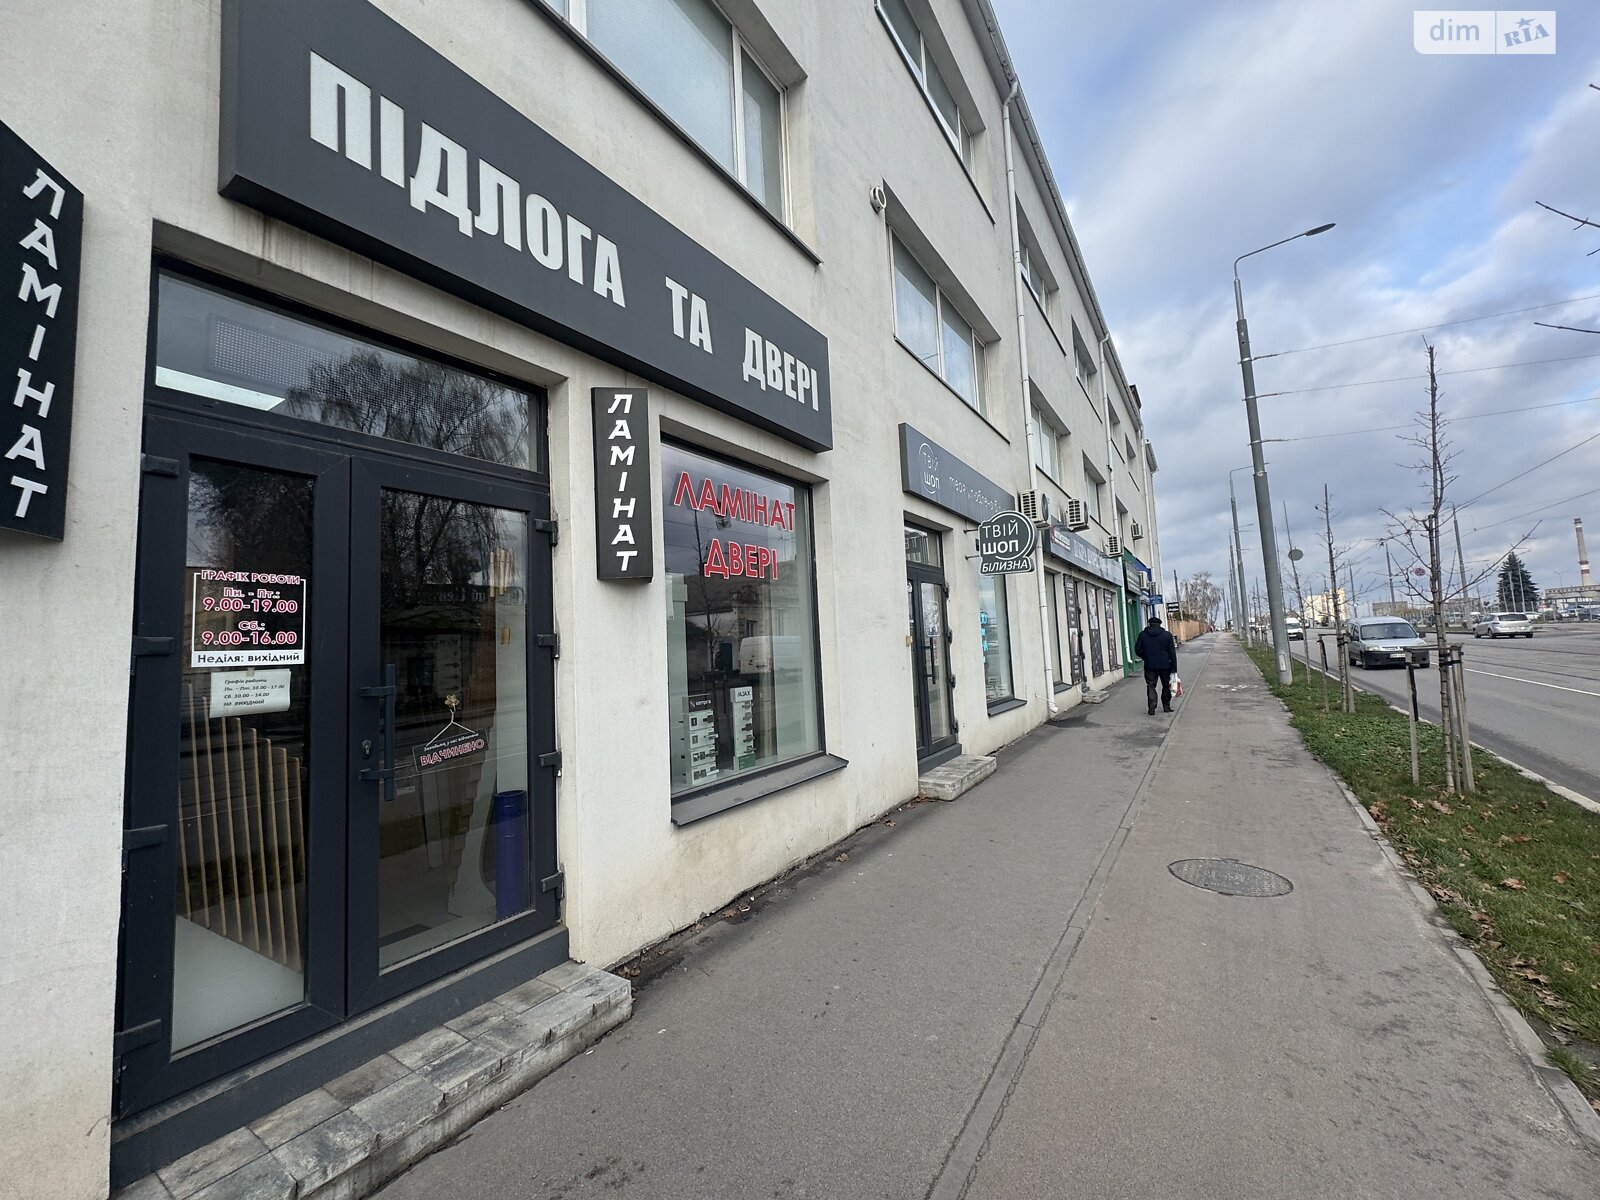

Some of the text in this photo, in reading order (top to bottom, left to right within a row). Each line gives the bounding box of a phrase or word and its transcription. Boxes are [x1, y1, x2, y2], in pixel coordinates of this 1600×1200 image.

[310, 50, 819, 411] ПІДЛОГА ТА ДВЕРІ
[5, 168, 66, 518] ЛАМІНАТ
[607, 394, 637, 572] ЛАМІНАТ
[673, 471, 796, 532] ЛАМІНАТ
[982, 519, 1018, 539] ТВІЙ
[982, 540, 1019, 555] ШОП
[704, 538, 778, 580] ДВЕРІ
[982, 559, 1028, 573] БІЛИЗНА
[201, 570, 300, 585] ГРАФІК РОБОТИ
[223, 587, 245, 598] Пн.
[203, 597, 298, 613] 9.00-19.00
[202, 631, 297, 645] 9.00-16.00
[198, 653, 300, 663] Неділя: вихідний
[420, 738, 485, 766] ВІДЧИНЕНО
